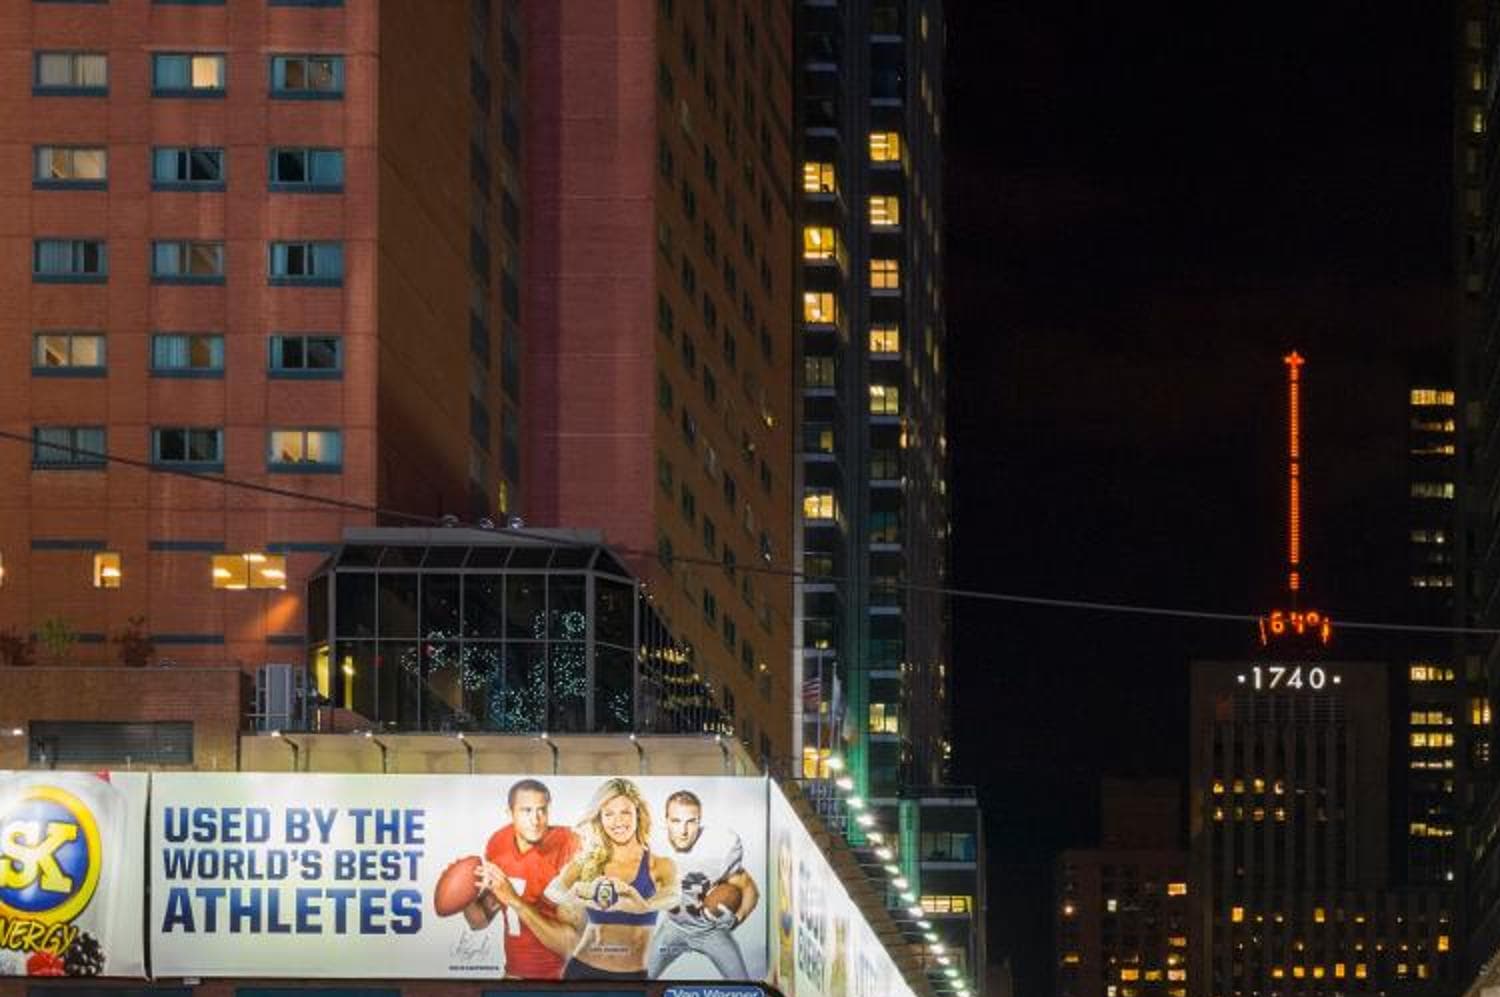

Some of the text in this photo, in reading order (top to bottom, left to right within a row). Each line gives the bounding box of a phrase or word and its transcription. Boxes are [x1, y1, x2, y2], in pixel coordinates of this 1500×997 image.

[1252, 666, 1326, 690] 1740
[164, 807, 425, 845] USED BY THE
[163, 848, 424, 881] WORLD'S BEST
[162, 887, 423, 934] ATHLETES
